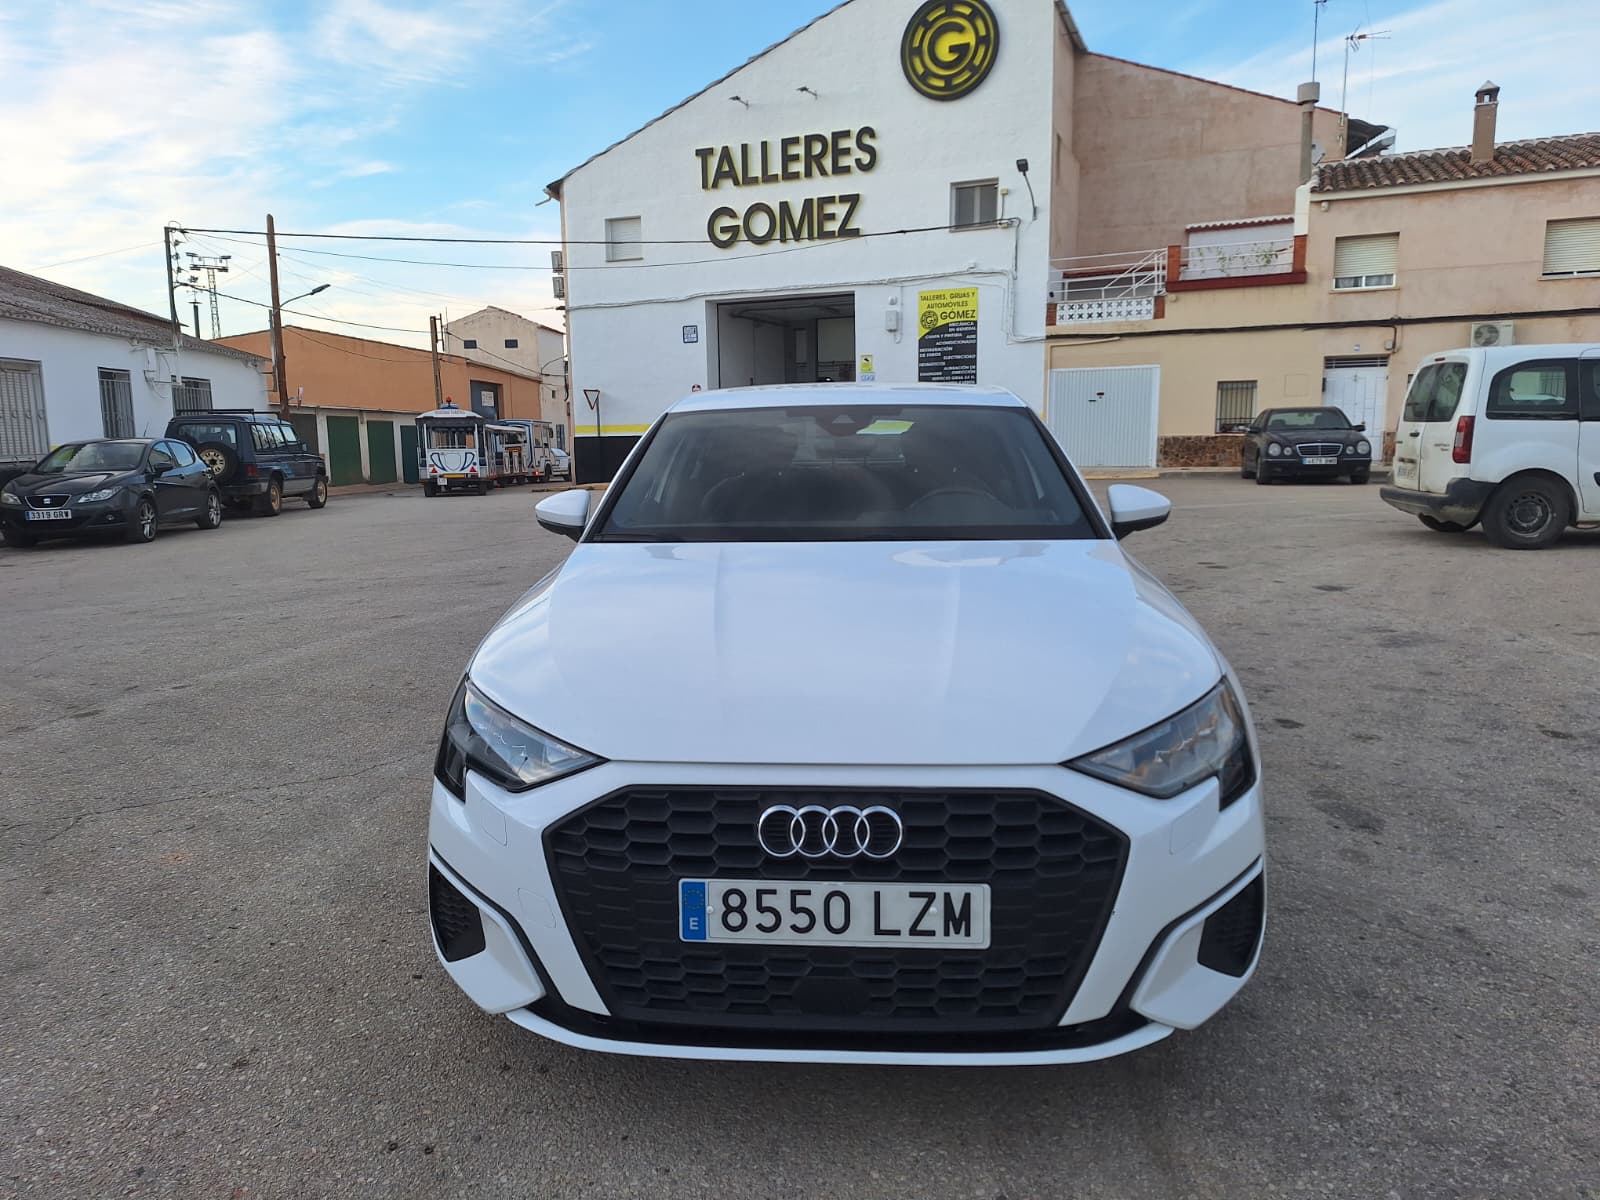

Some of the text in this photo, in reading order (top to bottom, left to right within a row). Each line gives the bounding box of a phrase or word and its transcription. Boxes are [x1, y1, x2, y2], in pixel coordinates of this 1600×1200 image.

[695, 126, 877, 190] TALLERES
[707, 193, 861, 249] GOMEZ
[940, 308, 976, 321] GÓMEZ
[689, 887, 972, 938] E 8550 LZM
